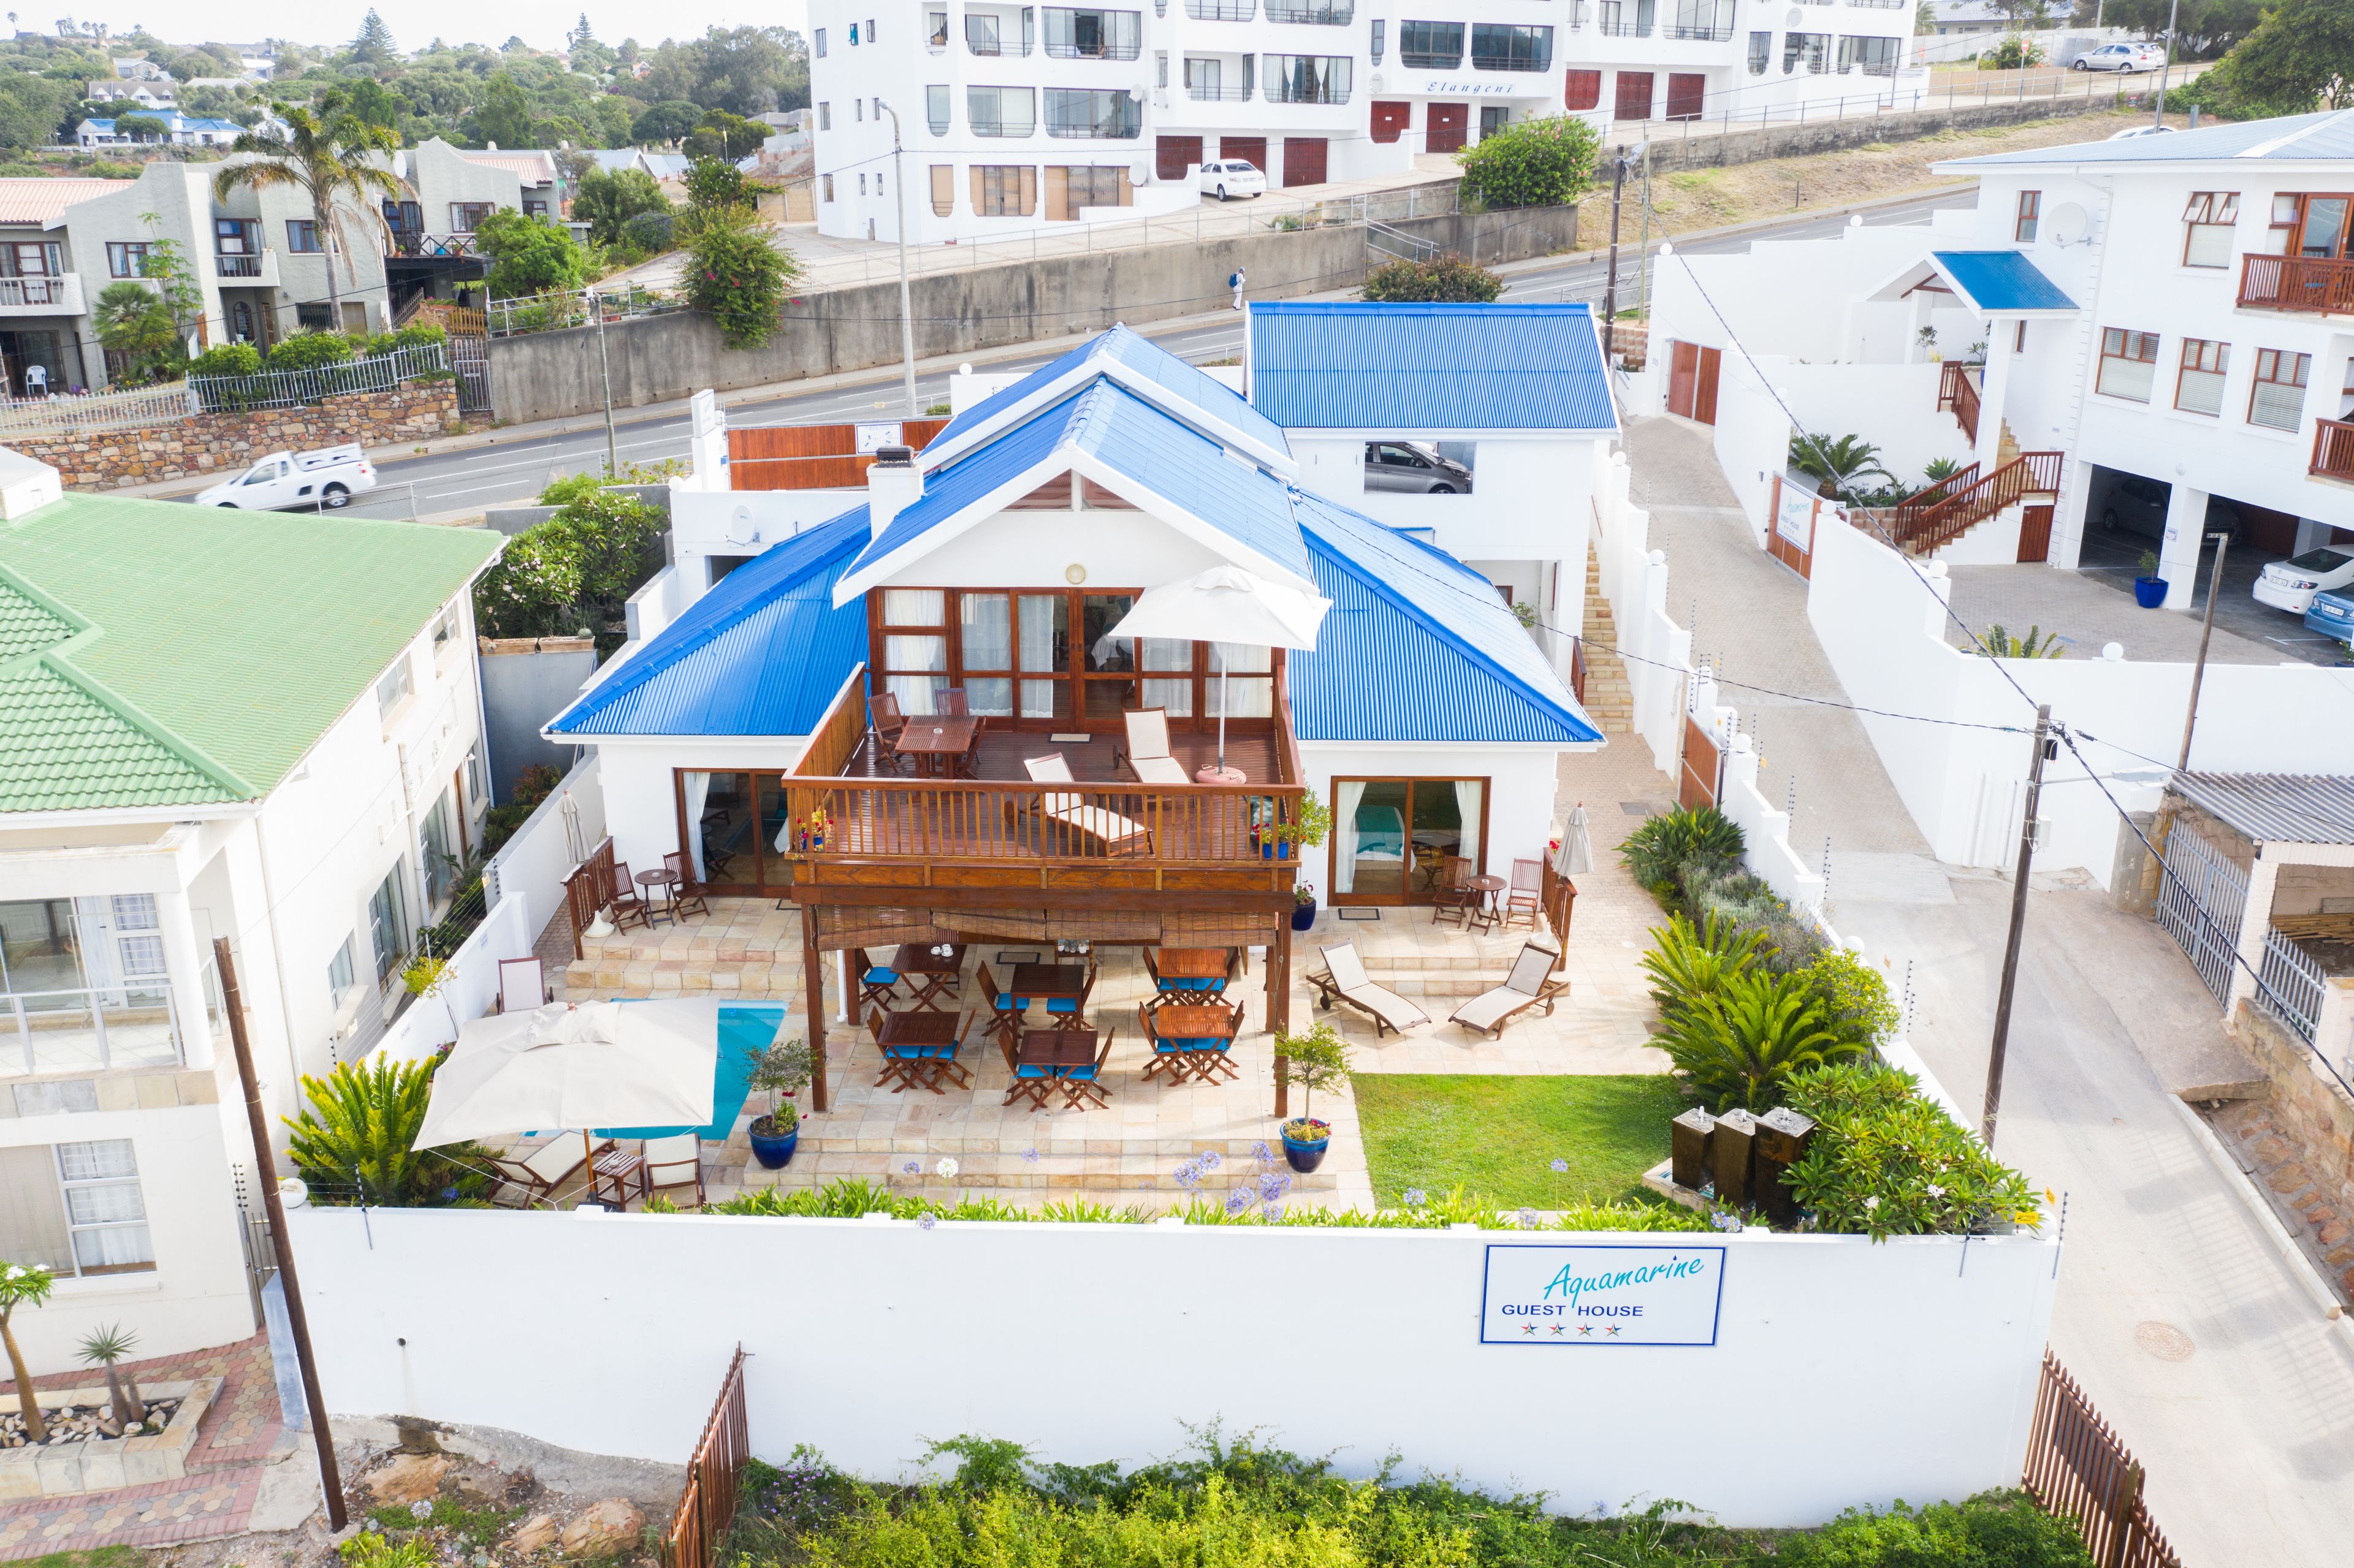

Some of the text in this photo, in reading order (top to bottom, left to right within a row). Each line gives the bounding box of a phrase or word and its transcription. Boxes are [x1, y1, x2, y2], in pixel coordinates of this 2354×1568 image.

[1428, 82, 1513, 94] Elangeni
[1544, 1255, 1704, 1308] Aquamarine
[1502, 1304, 1644, 1317] GUEST HOUSE
